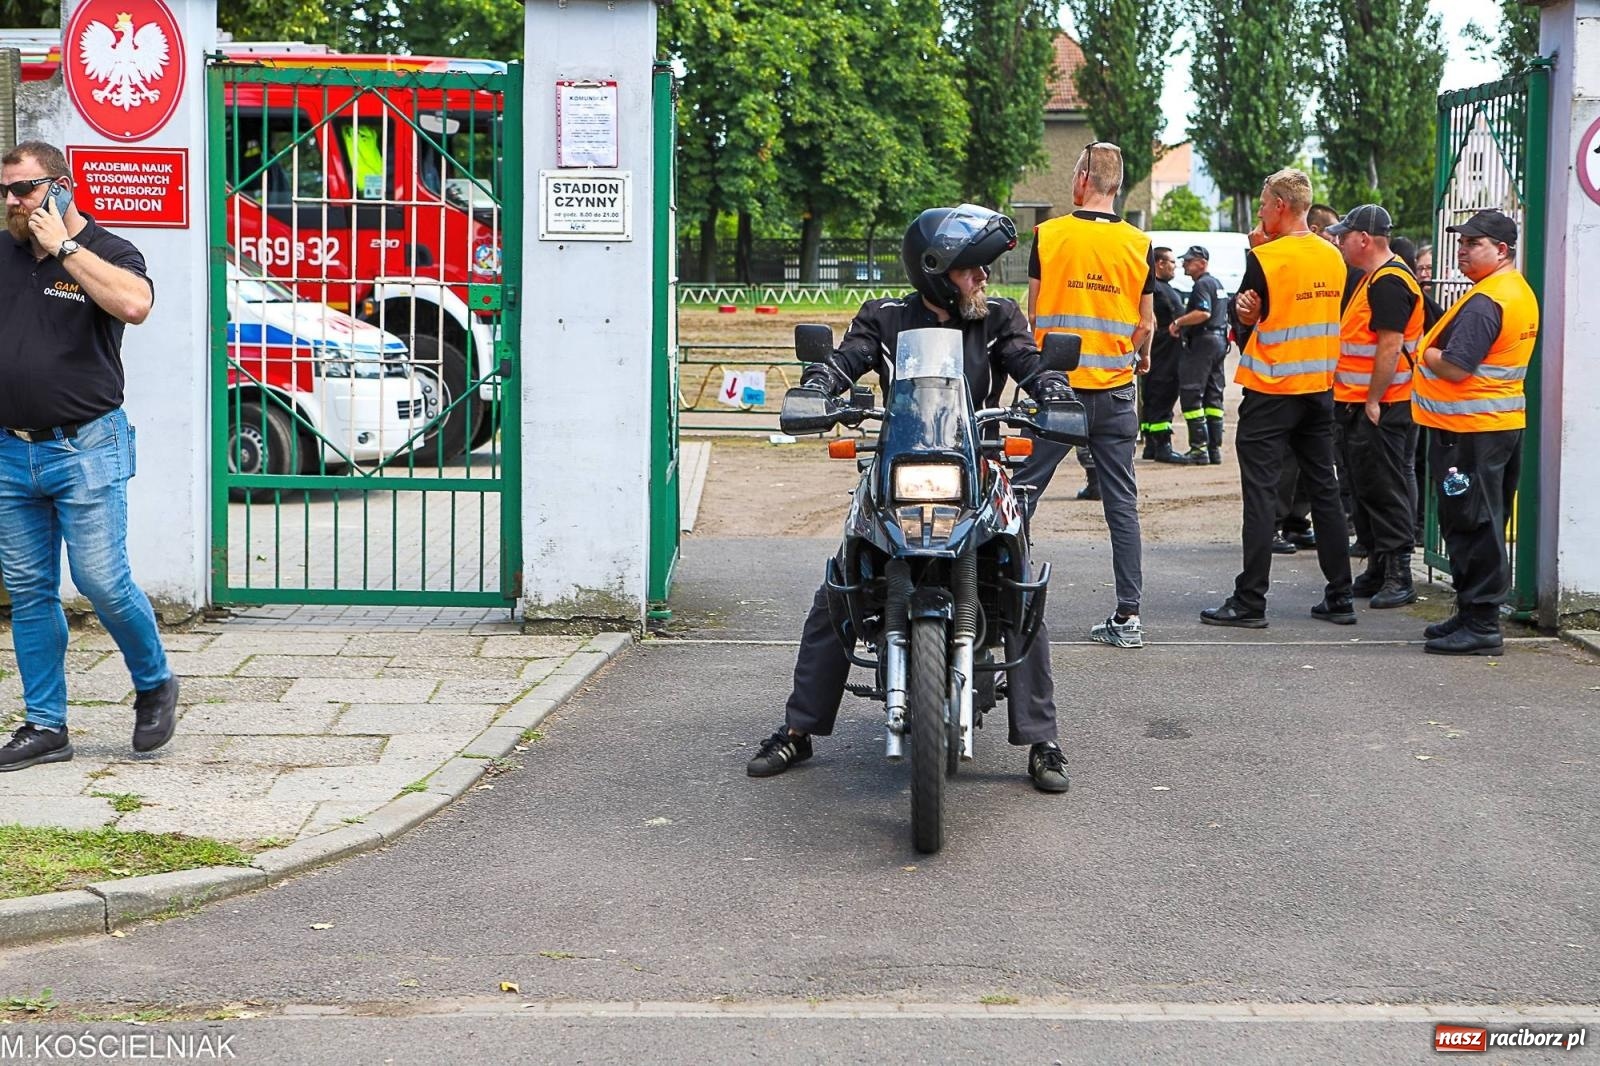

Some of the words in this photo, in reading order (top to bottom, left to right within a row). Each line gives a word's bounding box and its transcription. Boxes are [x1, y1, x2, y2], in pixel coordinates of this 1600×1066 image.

[82, 162, 140, 172] AKADEMIA
[141, 163, 173, 173] NAUK
[86, 173, 170, 184] STOSOWANYCH
[89, 185, 101, 194] W
[103, 185, 166, 196] RACIBORZU
[552, 182, 619, 194] STADION
[94, 198, 162, 211] STADION
[554, 196, 618, 208] CZYNNY
[241, 236, 290, 266] 569
[307, 236, 340, 266] 32
[54, 281, 79, 292] GAM
[43, 287, 86, 303] OCHRONA
